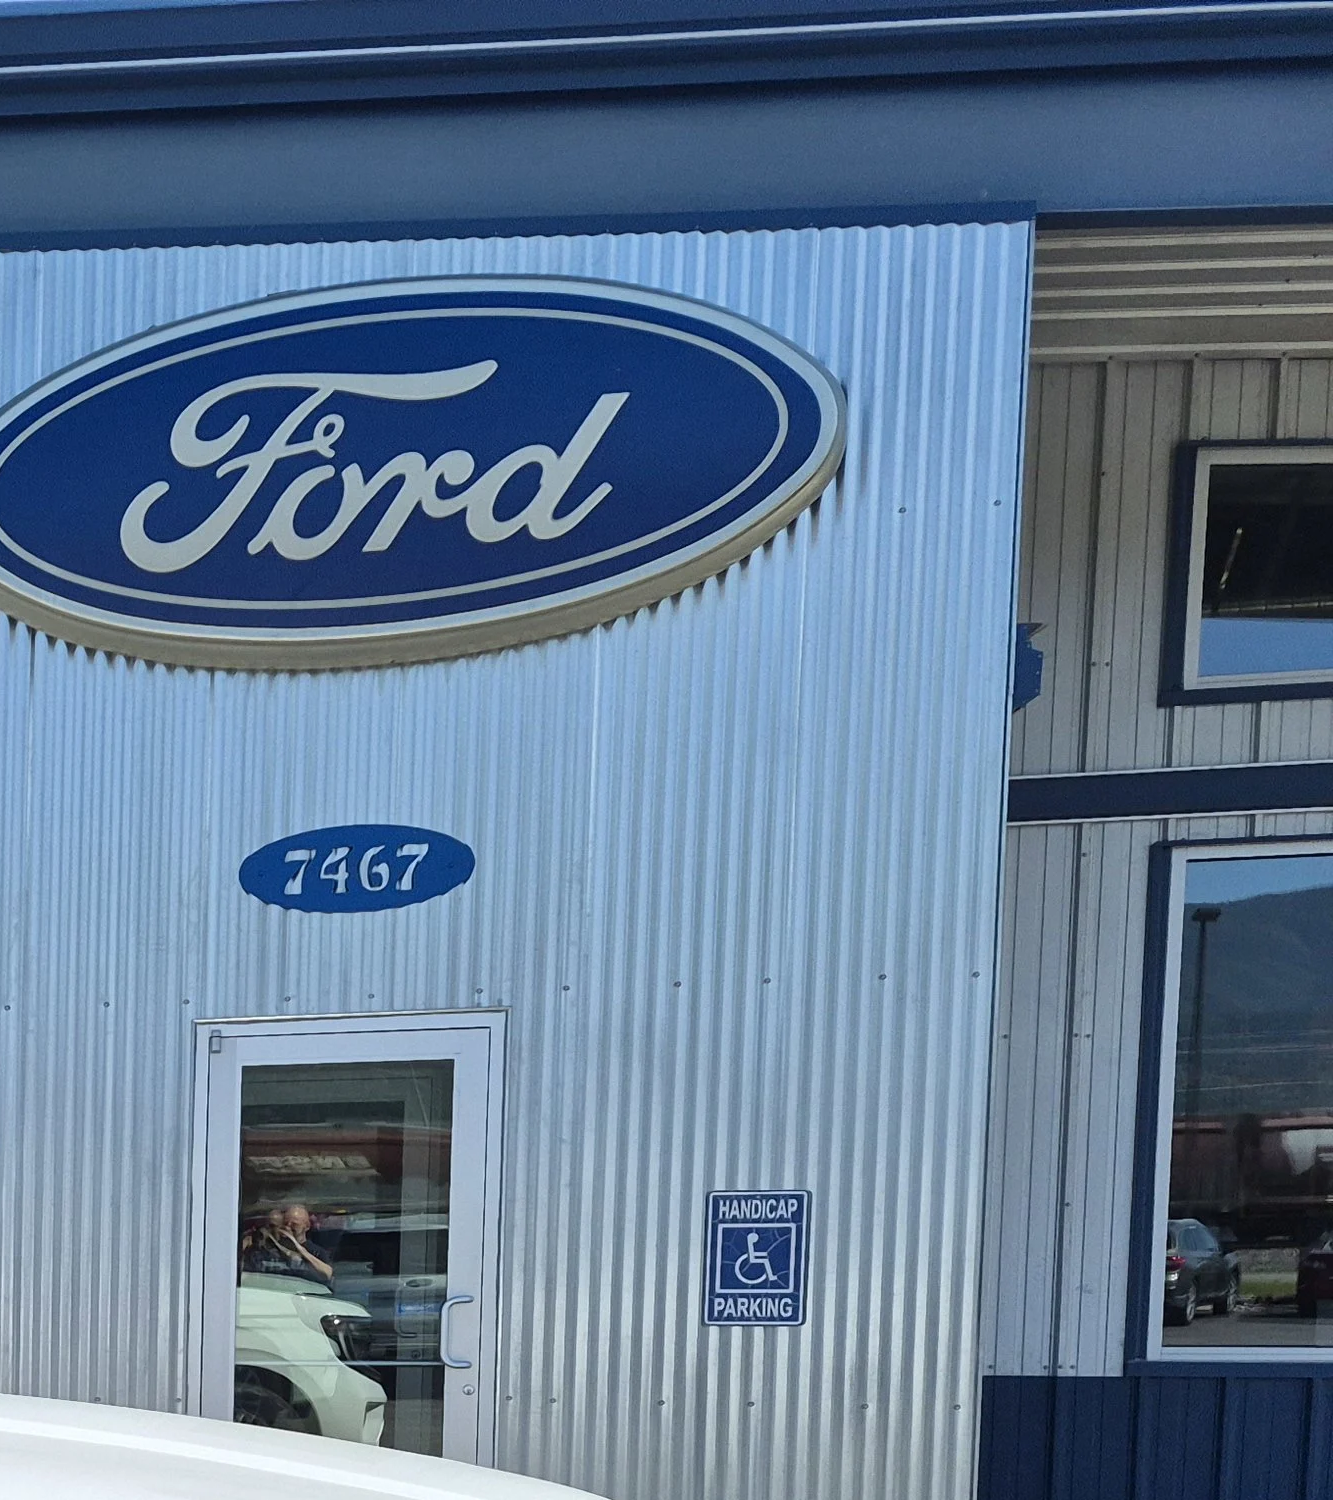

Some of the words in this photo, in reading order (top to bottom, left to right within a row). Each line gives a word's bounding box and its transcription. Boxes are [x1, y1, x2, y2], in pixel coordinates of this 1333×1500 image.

[120, 359, 631, 573] Ford
[284, 843, 429, 895] 7467
[718, 1198, 798, 1219] HANDICAP
[714, 1297, 793, 1318] PARKING
